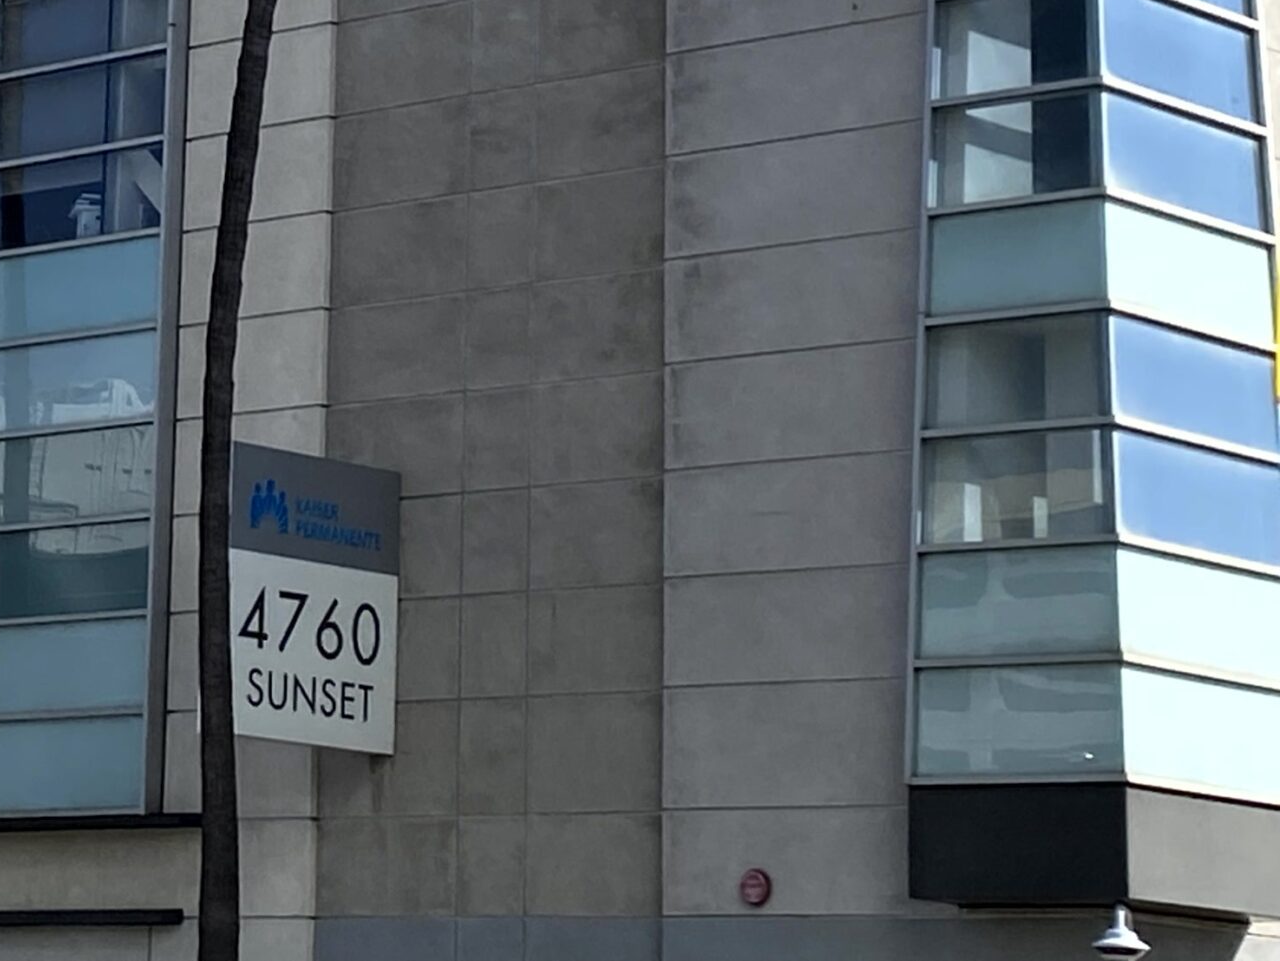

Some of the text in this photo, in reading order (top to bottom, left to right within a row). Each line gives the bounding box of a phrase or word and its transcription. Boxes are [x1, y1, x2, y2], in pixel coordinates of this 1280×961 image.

[296, 497, 339, 521] KAISER
[295, 521, 381, 551] PERMANENTE
[238, 587, 380, 666] 4760
[247, 668, 374, 722] SUNSET
